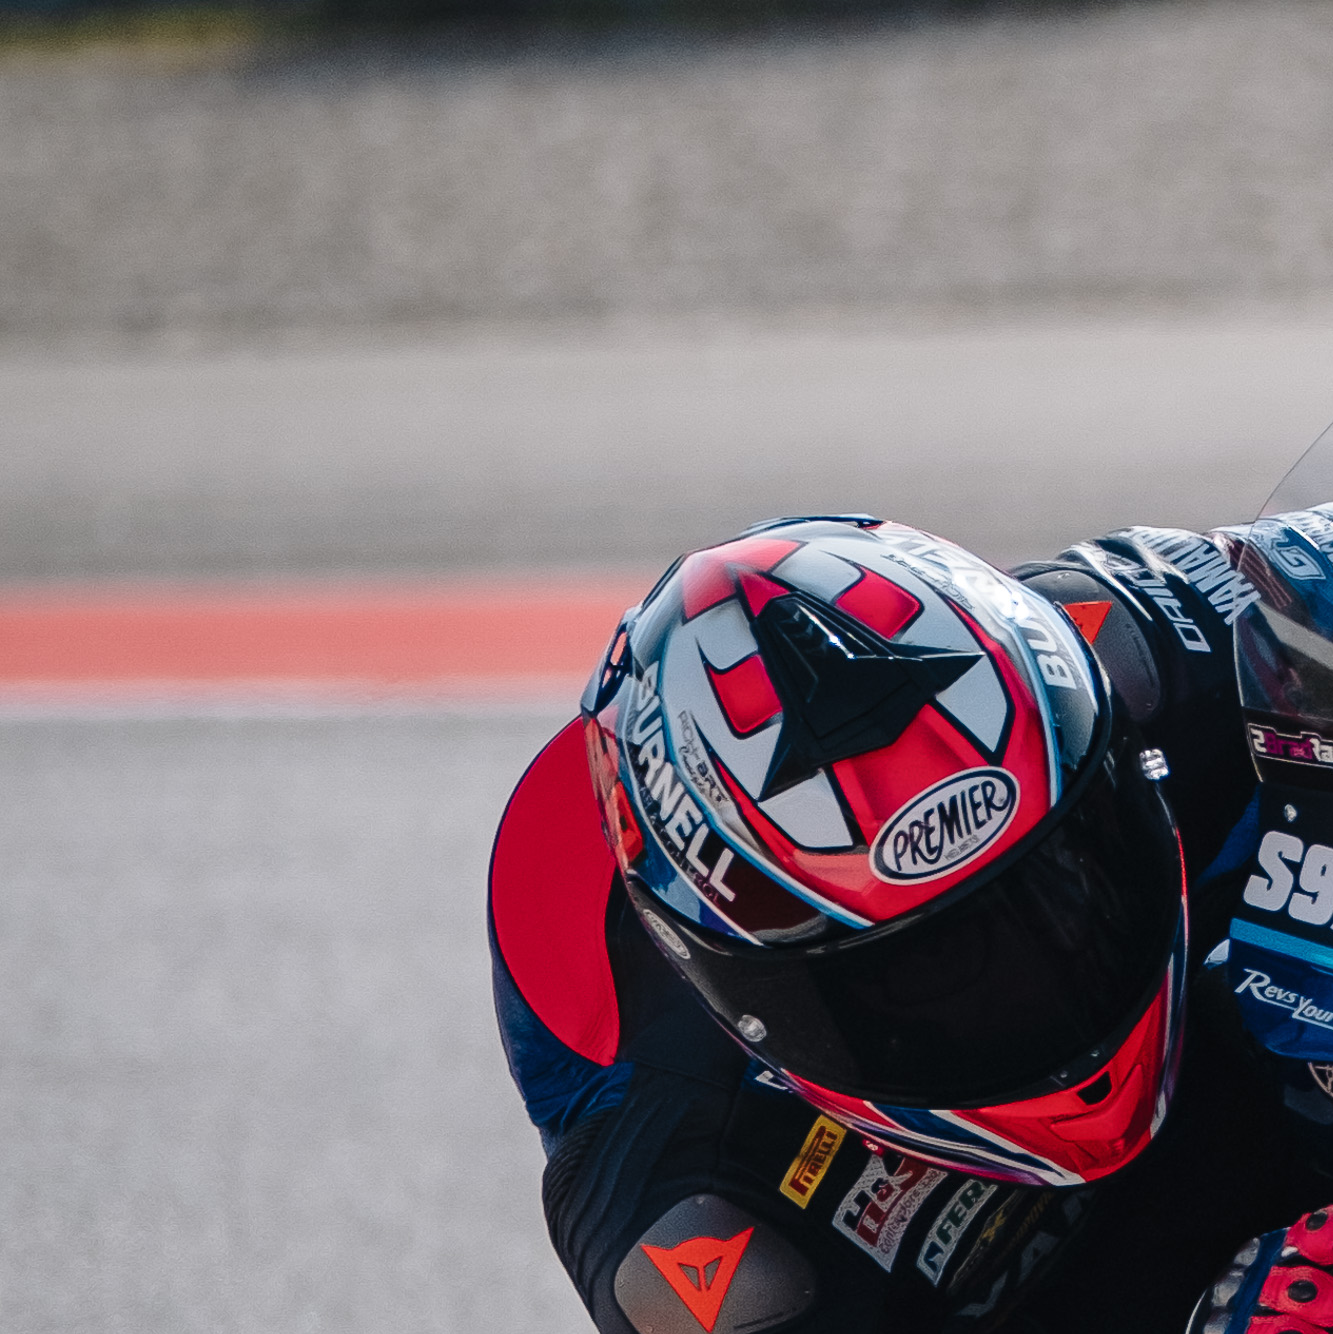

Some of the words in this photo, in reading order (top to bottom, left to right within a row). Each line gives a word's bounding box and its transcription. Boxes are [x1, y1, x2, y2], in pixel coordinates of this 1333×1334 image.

[632, 661, 736, 902] BURNELL
[893, 780, 1010, 871] PREMIER
[1235, 967, 1300, 1007] Revs
[789, 1126, 838, 1196] PIRELLI
